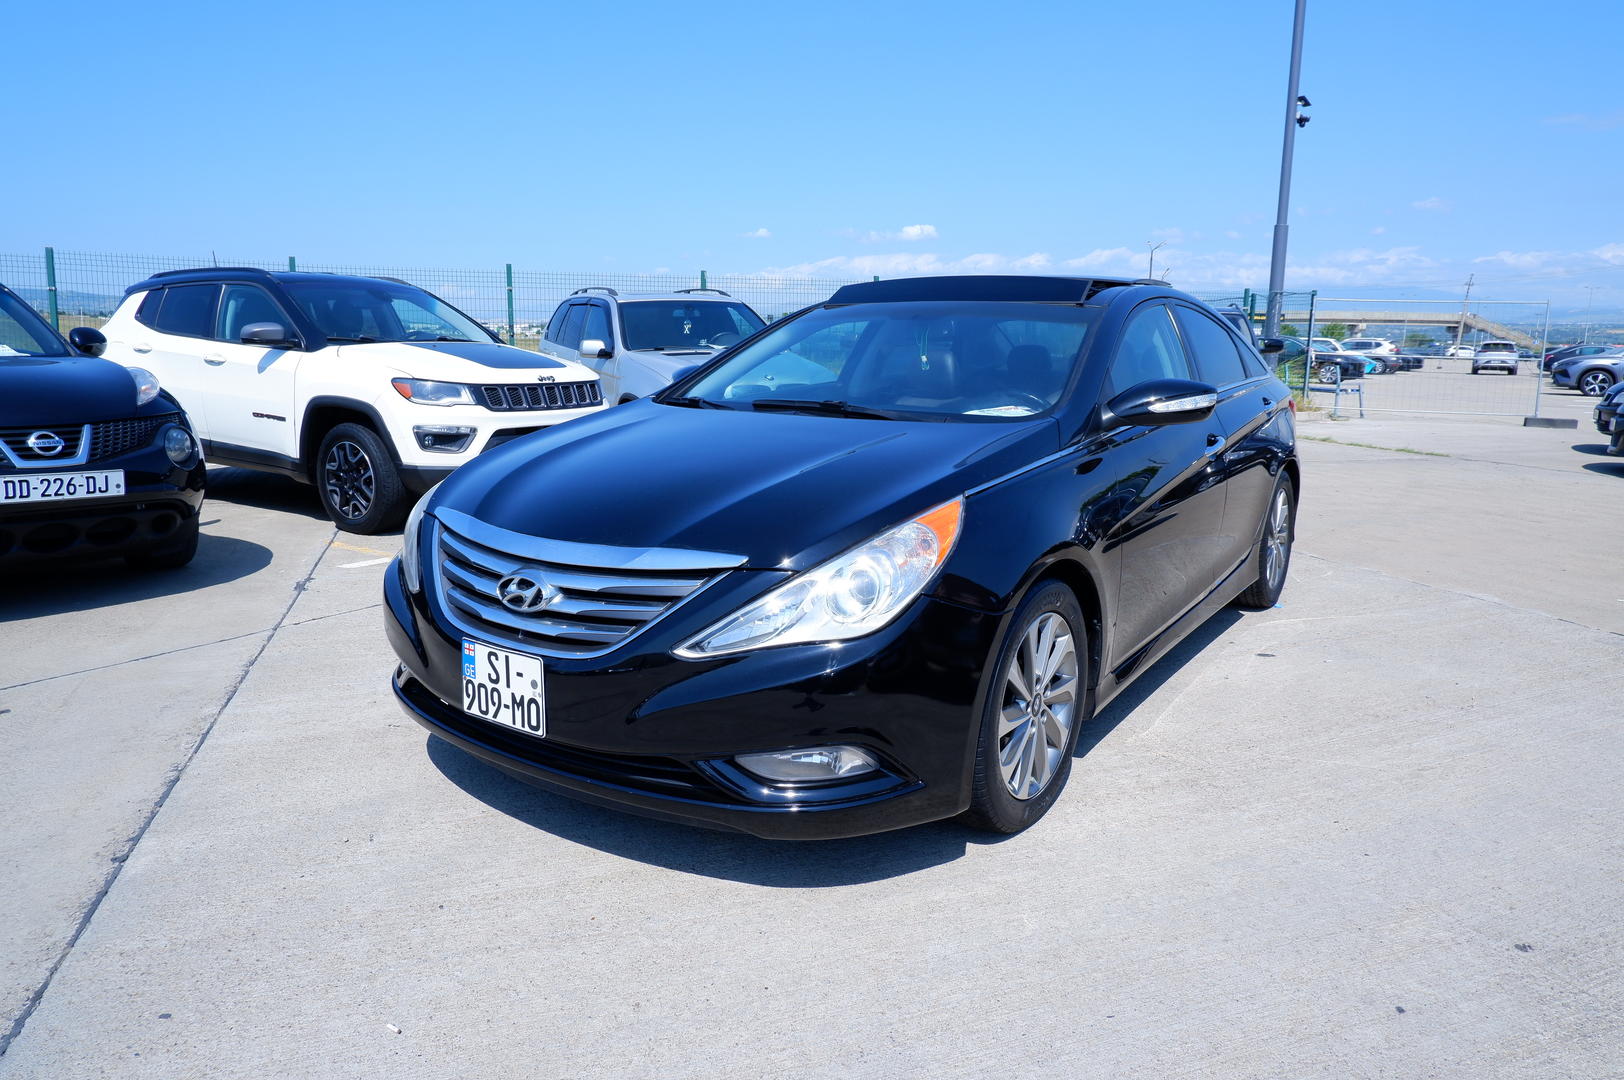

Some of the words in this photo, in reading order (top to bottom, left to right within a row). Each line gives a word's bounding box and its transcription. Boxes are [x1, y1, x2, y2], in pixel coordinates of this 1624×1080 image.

[537, 375, 556, 383] Jeep
[3, 475, 109, 499] DD-226-DJ
[464, 663, 475, 678] GE
[487, 651, 524, 689] SI-
[465, 679, 541, 732] 909-MO
